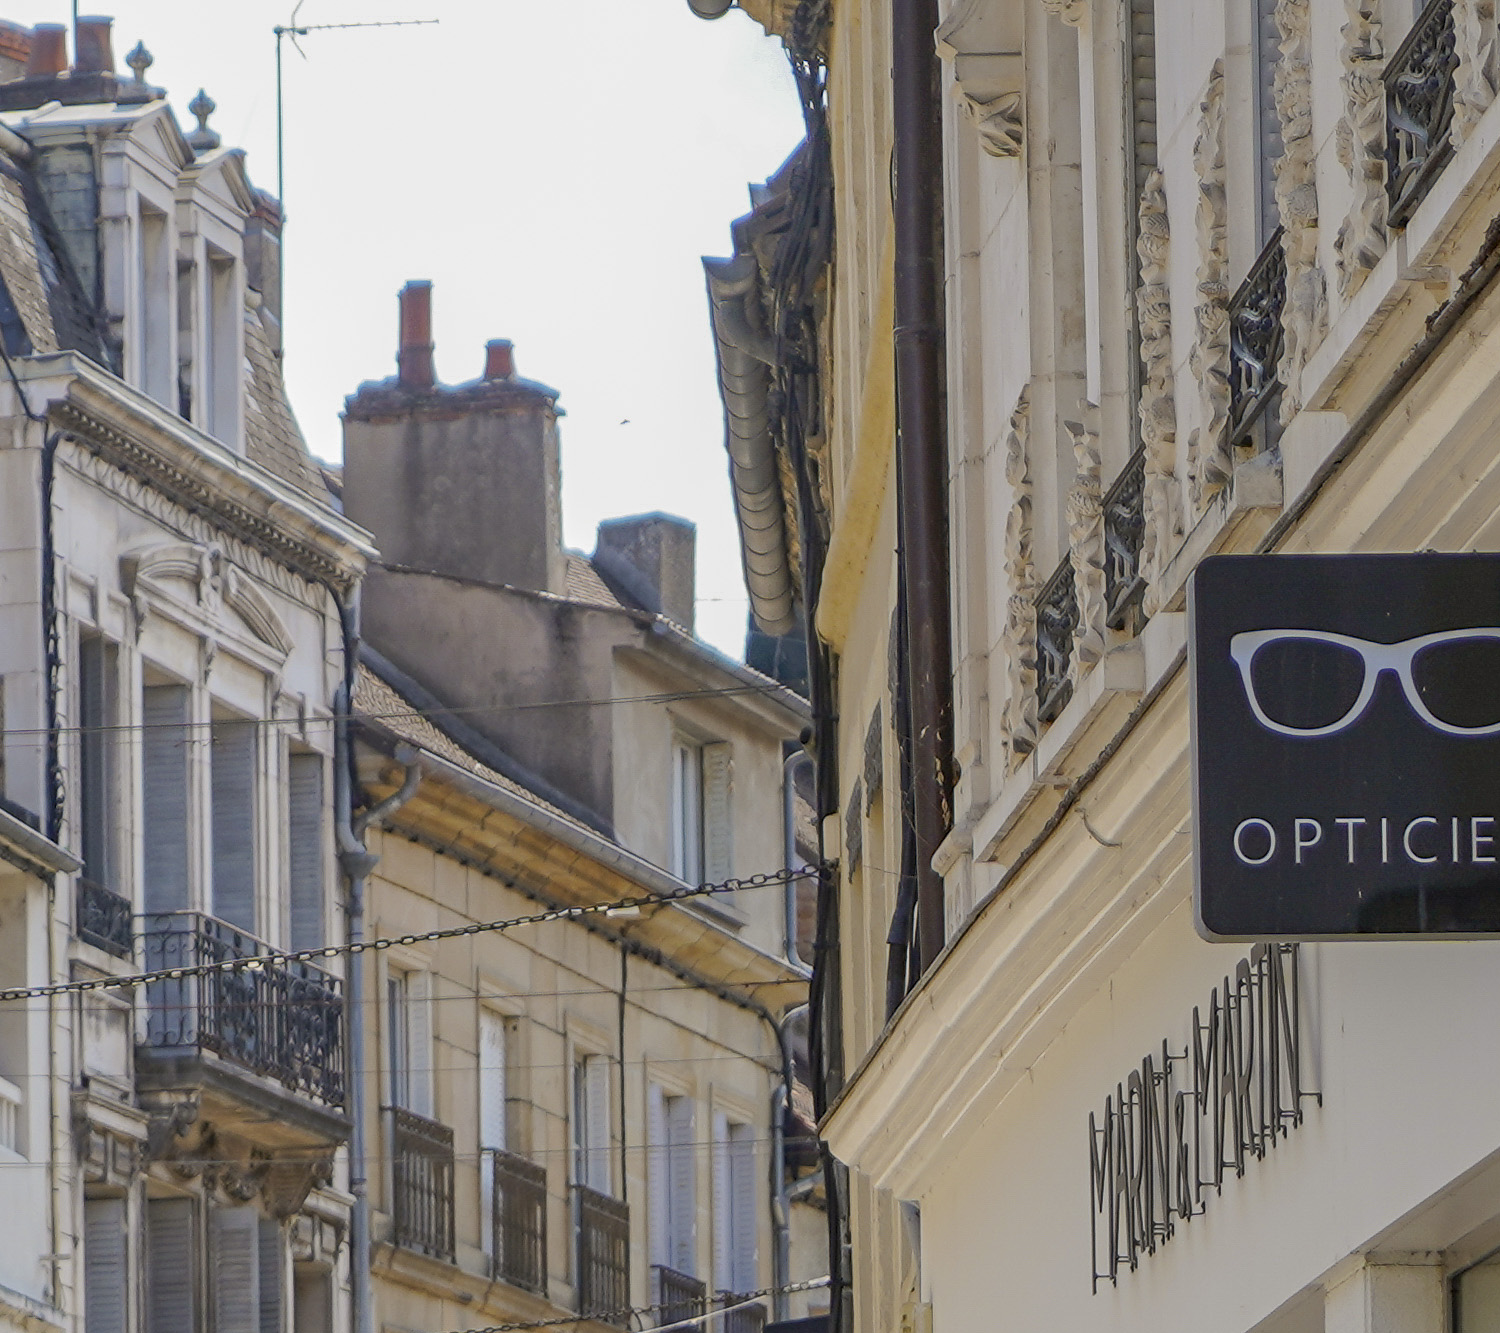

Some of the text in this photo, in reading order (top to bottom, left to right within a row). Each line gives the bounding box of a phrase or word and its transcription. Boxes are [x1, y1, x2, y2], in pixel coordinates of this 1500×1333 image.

[1088, 941, 1301, 1296] MARIN & MARIN
